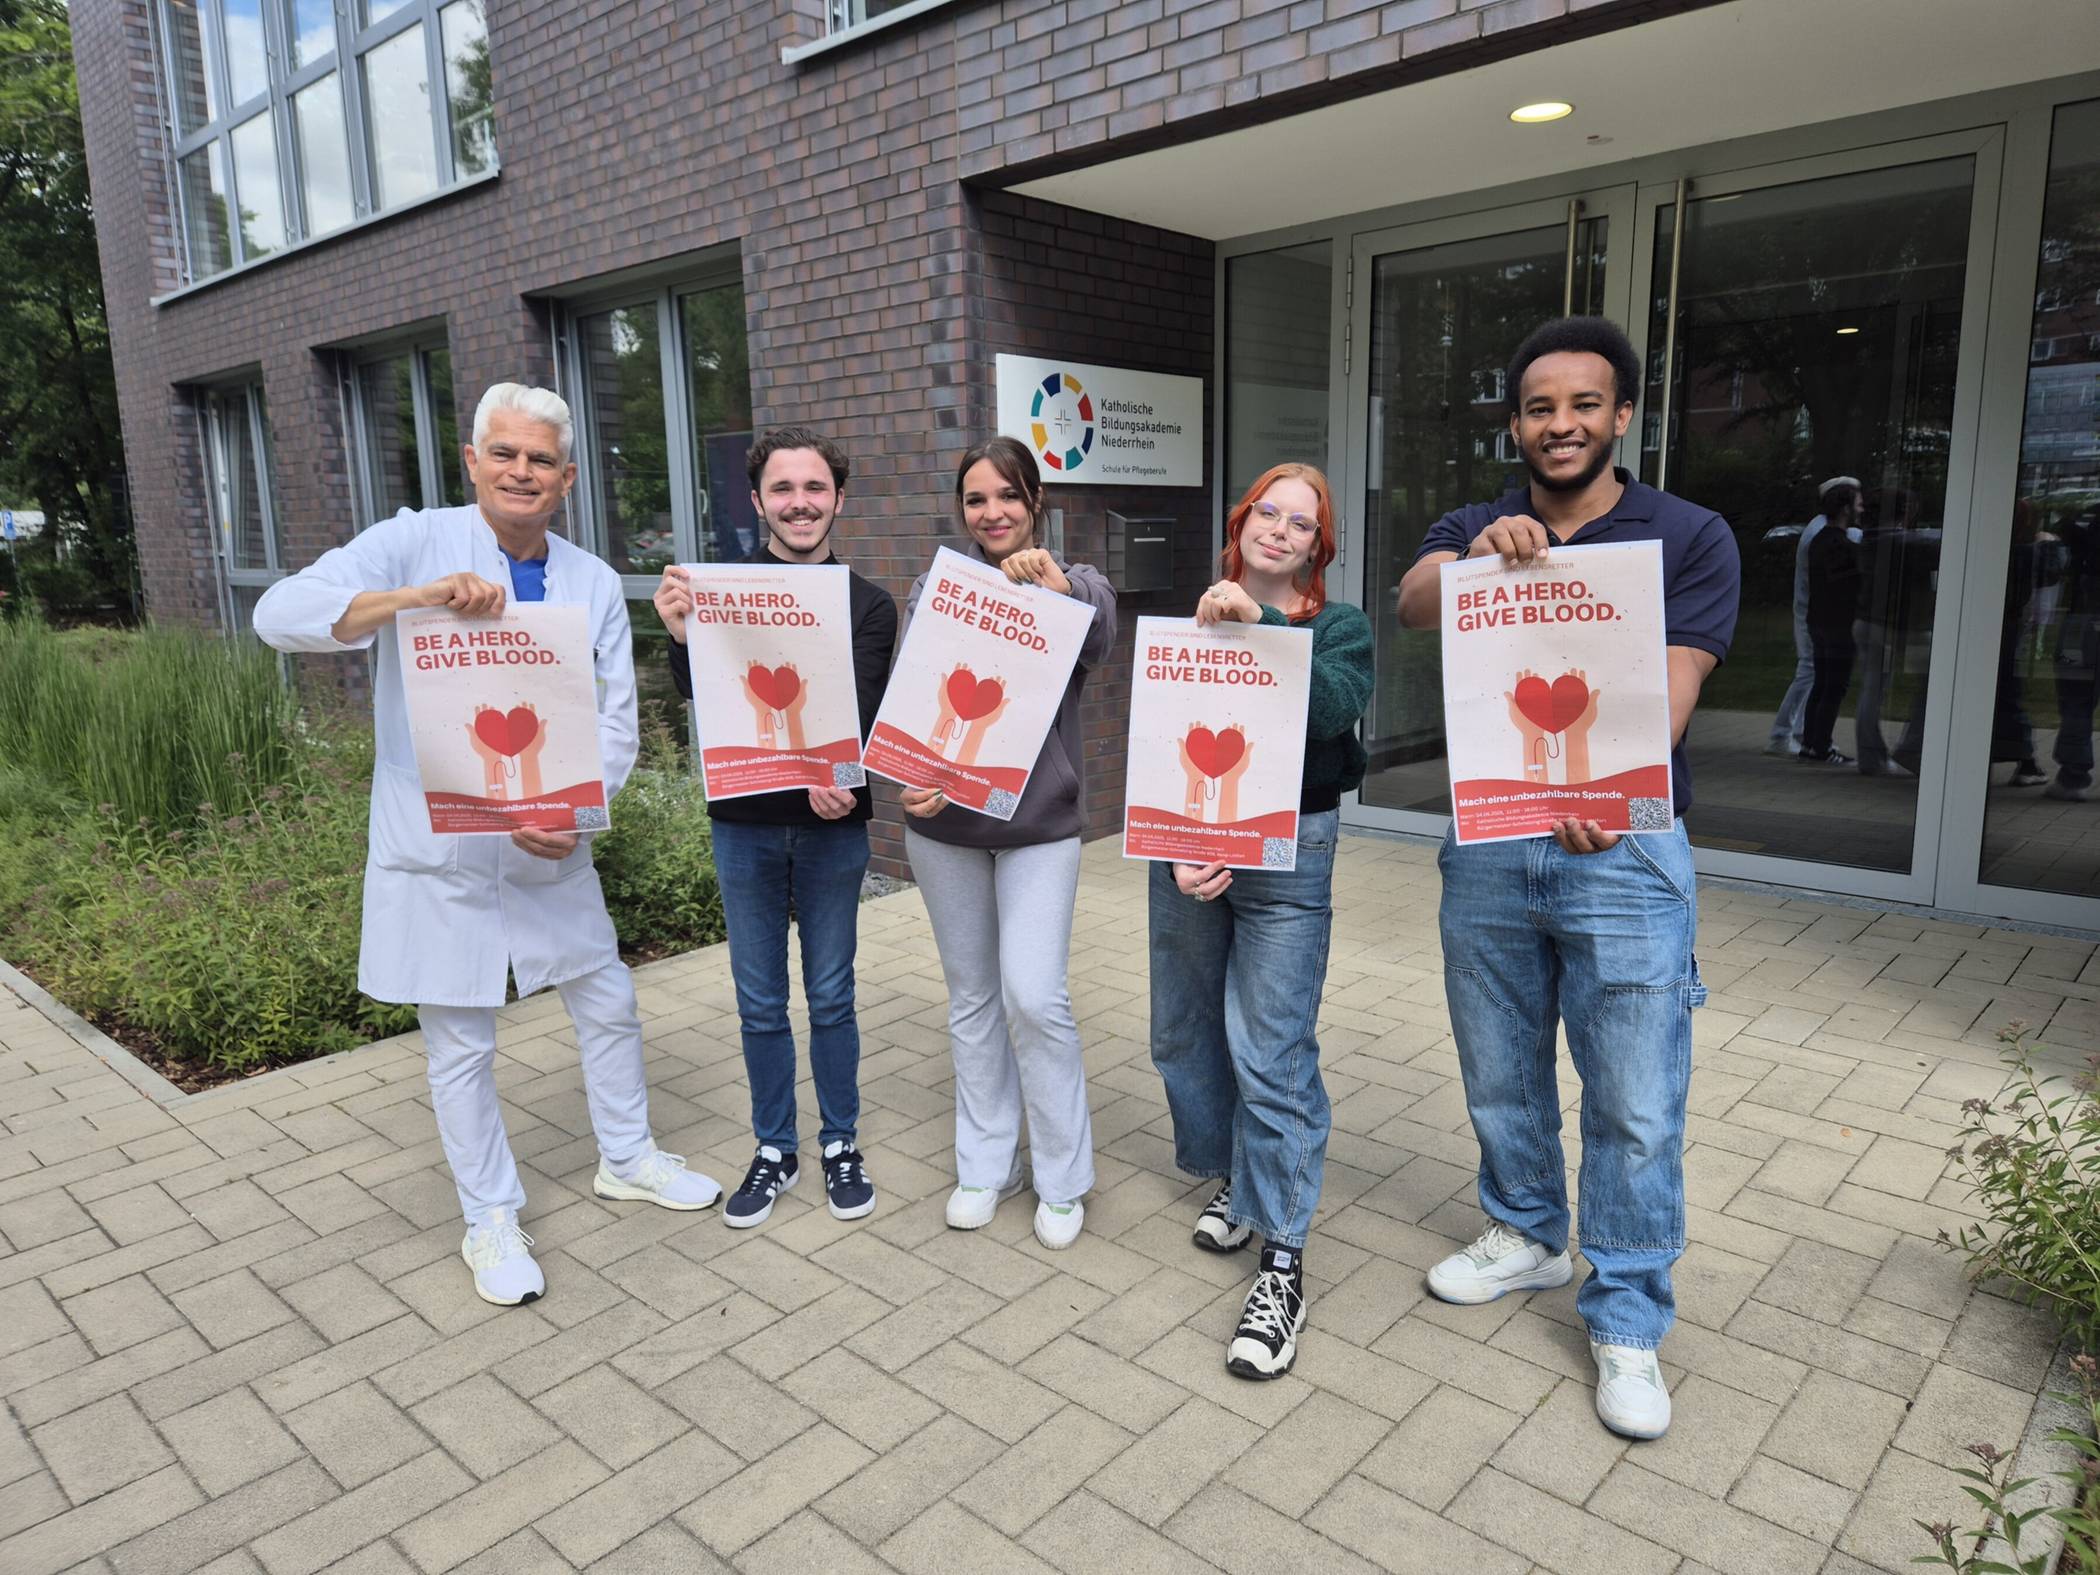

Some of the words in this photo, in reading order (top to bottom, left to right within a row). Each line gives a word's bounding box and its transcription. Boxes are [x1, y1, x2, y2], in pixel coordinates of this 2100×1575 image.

[1100, 398, 1153, 415] Katholische
[1101, 417, 1182, 436] Bildungsakademie
[1101, 434, 1155, 450] Niederrhein
[1102, 464, 1121, 474] Schule
[1122, 465, 1131, 474] für
[1131, 465, 1167, 476] Pflegeberufe
[695, 592, 719, 606] BE
[723, 593, 736, 607] A
[740, 593, 800, 608] HERO.
[937, 578, 964, 600] BE
[963, 590, 977, 605] A
[980, 596, 1037, 630] HERO.
[1457, 589, 1488, 612] BE
[1491, 586, 1510, 606] A
[1515, 581, 1594, 602] HERO.
[698, 609, 743, 624] GIVE
[747, 611, 821, 627] BLOOD.
[931, 596, 978, 626] GIVE
[978, 616, 1048, 654] BLOOD.
[1457, 608, 1516, 632] GIVE
[1522, 603, 1622, 625] BLOOD.
[413, 634, 443, 652] BE
[449, 633, 464, 648] A
[468, 631, 537, 648] HERO.
[416, 652, 472, 670] GIVE
[477, 650, 561, 666] BLOOD.
[1147, 646, 1173, 662] BE
[1176, 648, 1191, 663] A
[1195, 648, 1259, 667] HERO.
[1146, 665, 1194, 682] GIVE
[1200, 668, 1278, 687] BLOOD.
[707, 761, 729, 769] Mach
[748, 754, 800, 765] unbezahlbare
[801, 755, 830, 764] Spende.
[873, 734, 894, 748] Mach
[894, 744, 910, 754] eine
[911, 751, 961, 776] unbezahlbare
[962, 771, 992, 787] Spende.
[536, 802, 571, 810] Spende.
[1458, 795, 1486, 807] Mach
[1487, 795, 1509, 805] eine
[1510, 791, 1580, 804] unbezahlbare
[1582, 790, 1625, 800] Spende.
[1129, 820, 1152, 829] Mach
[1171, 825, 1227, 836] unbezahlbare
[1228, 829, 1262, 838] Spende.
